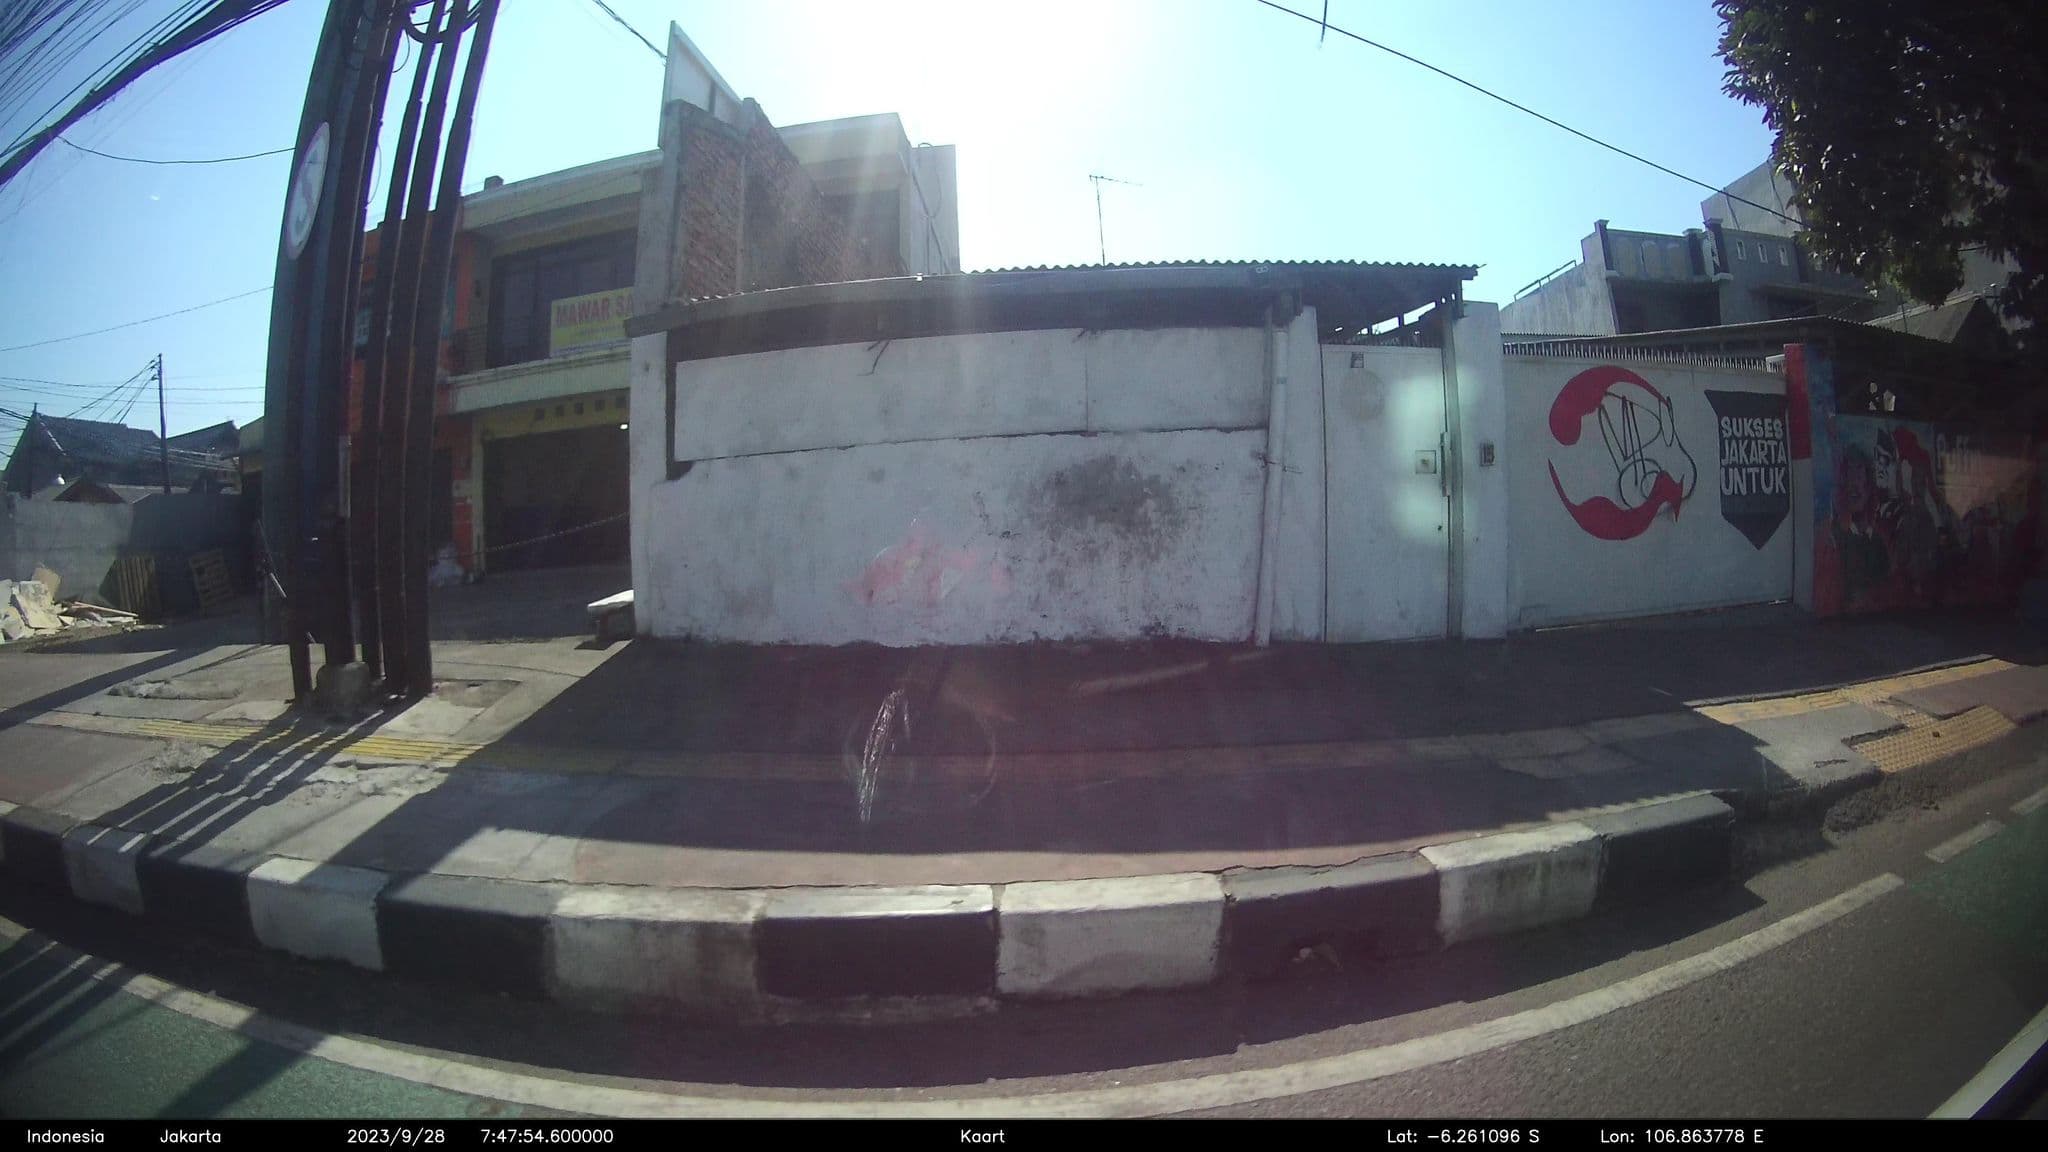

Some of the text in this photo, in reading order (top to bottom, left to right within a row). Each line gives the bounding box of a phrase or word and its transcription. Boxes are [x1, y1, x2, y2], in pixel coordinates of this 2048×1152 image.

[556, 296, 610, 323] MAWAR
[1720, 415, 1784, 440] SUKSES
[1720, 439, 1787, 466] JAKARTA
[1720, 466, 1787, 497] UNTUK
